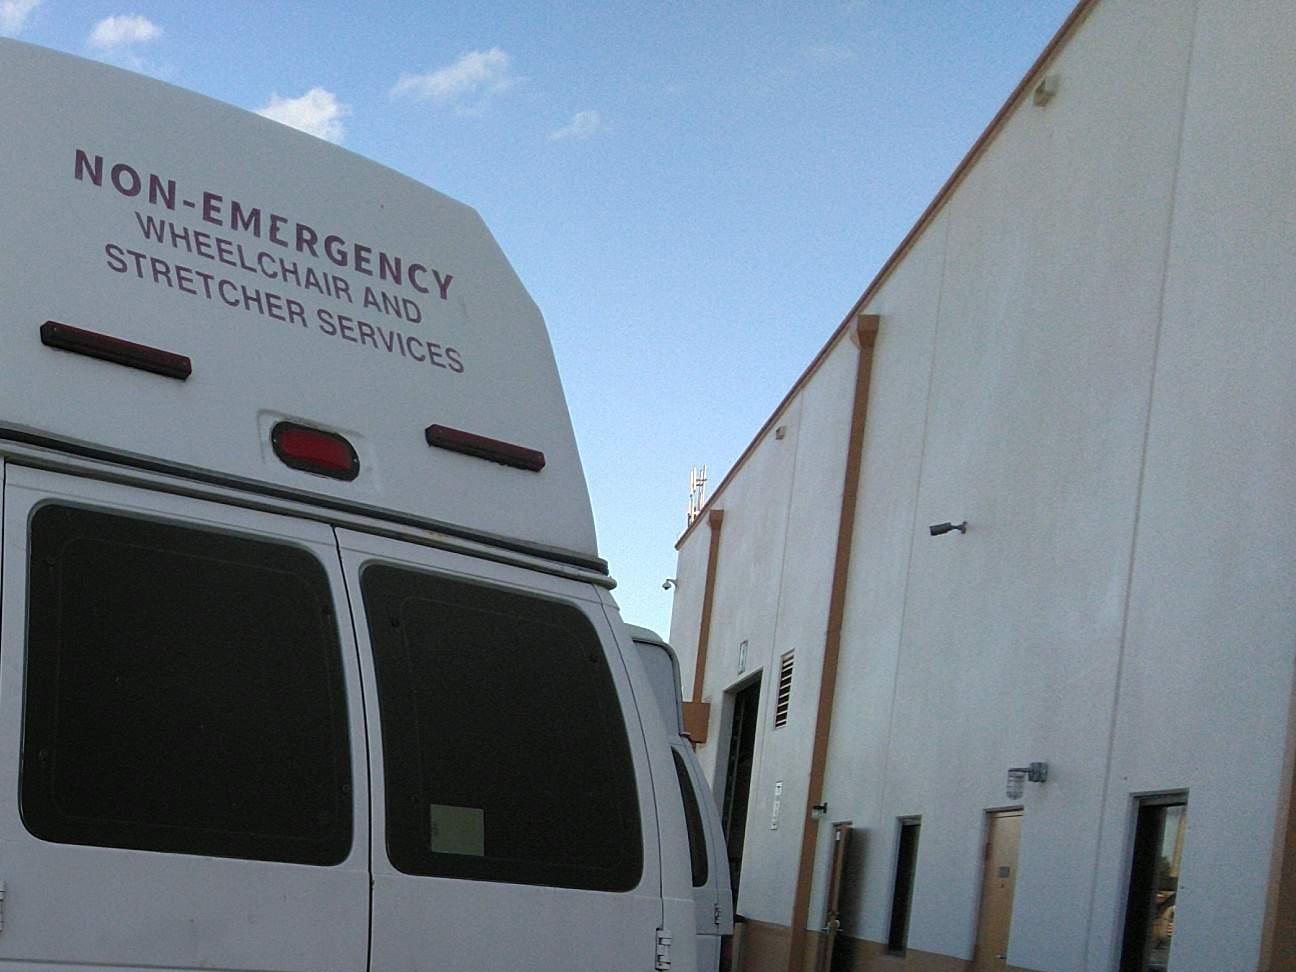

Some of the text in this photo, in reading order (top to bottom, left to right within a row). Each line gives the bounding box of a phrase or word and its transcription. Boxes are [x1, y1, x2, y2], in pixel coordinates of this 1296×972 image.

[74, 149, 454, 301] NON-EMERGENCY
[134, 211, 423, 324] WHEELCHAIR AND
[104, 243, 465, 374] STRETCHER SERVICES
